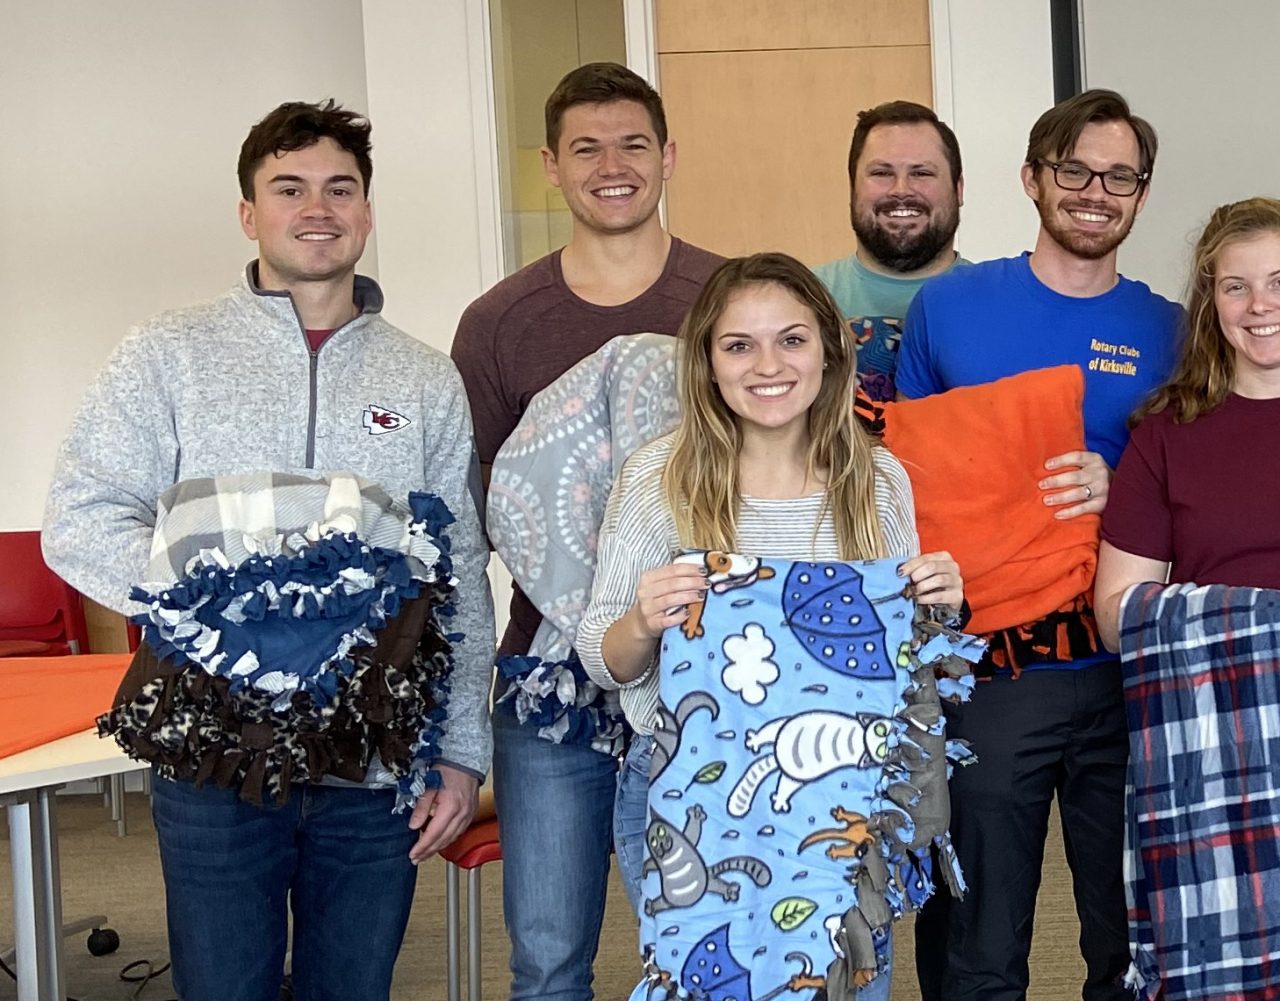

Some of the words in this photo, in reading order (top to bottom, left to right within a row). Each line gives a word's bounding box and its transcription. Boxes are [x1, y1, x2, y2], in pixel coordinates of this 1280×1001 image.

[1090, 338, 1117, 356] Rotary
[1119, 345, 1140, 358] Clubs
[1088, 357, 1099, 370] of
[1099, 359, 1137, 376] Kirksville
